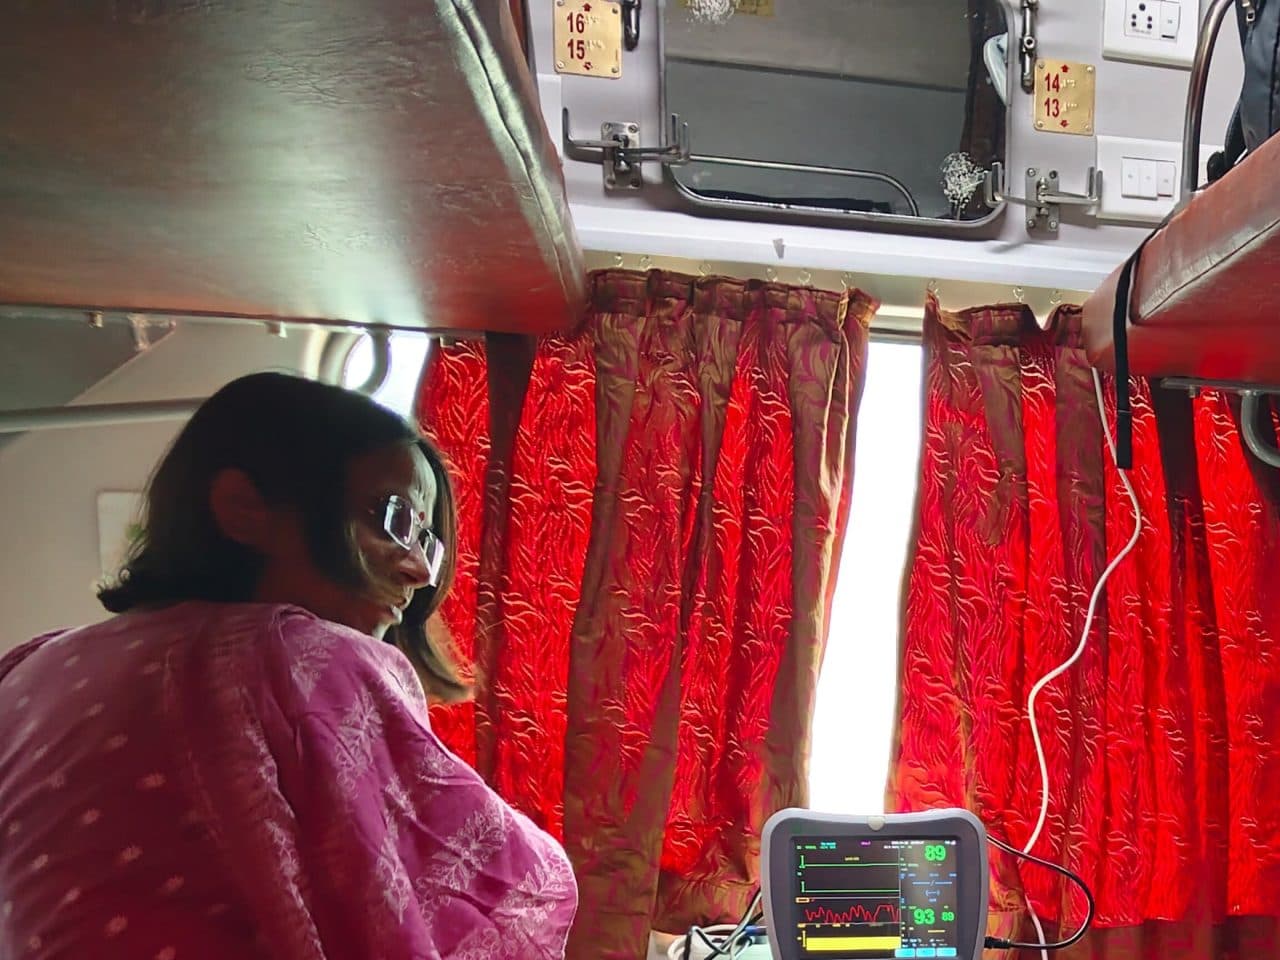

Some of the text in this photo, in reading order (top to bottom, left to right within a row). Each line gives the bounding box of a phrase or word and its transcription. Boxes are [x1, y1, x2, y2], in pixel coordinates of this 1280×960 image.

[566, 12, 585, 33] 16
[567, 39, 585, 60] 15
[1044, 72, 1060, 93] 14
[1044, 97, 1060, 118] 13
[924, 845, 947, 861] 89
[913, 908, 955, 925] 93 89
